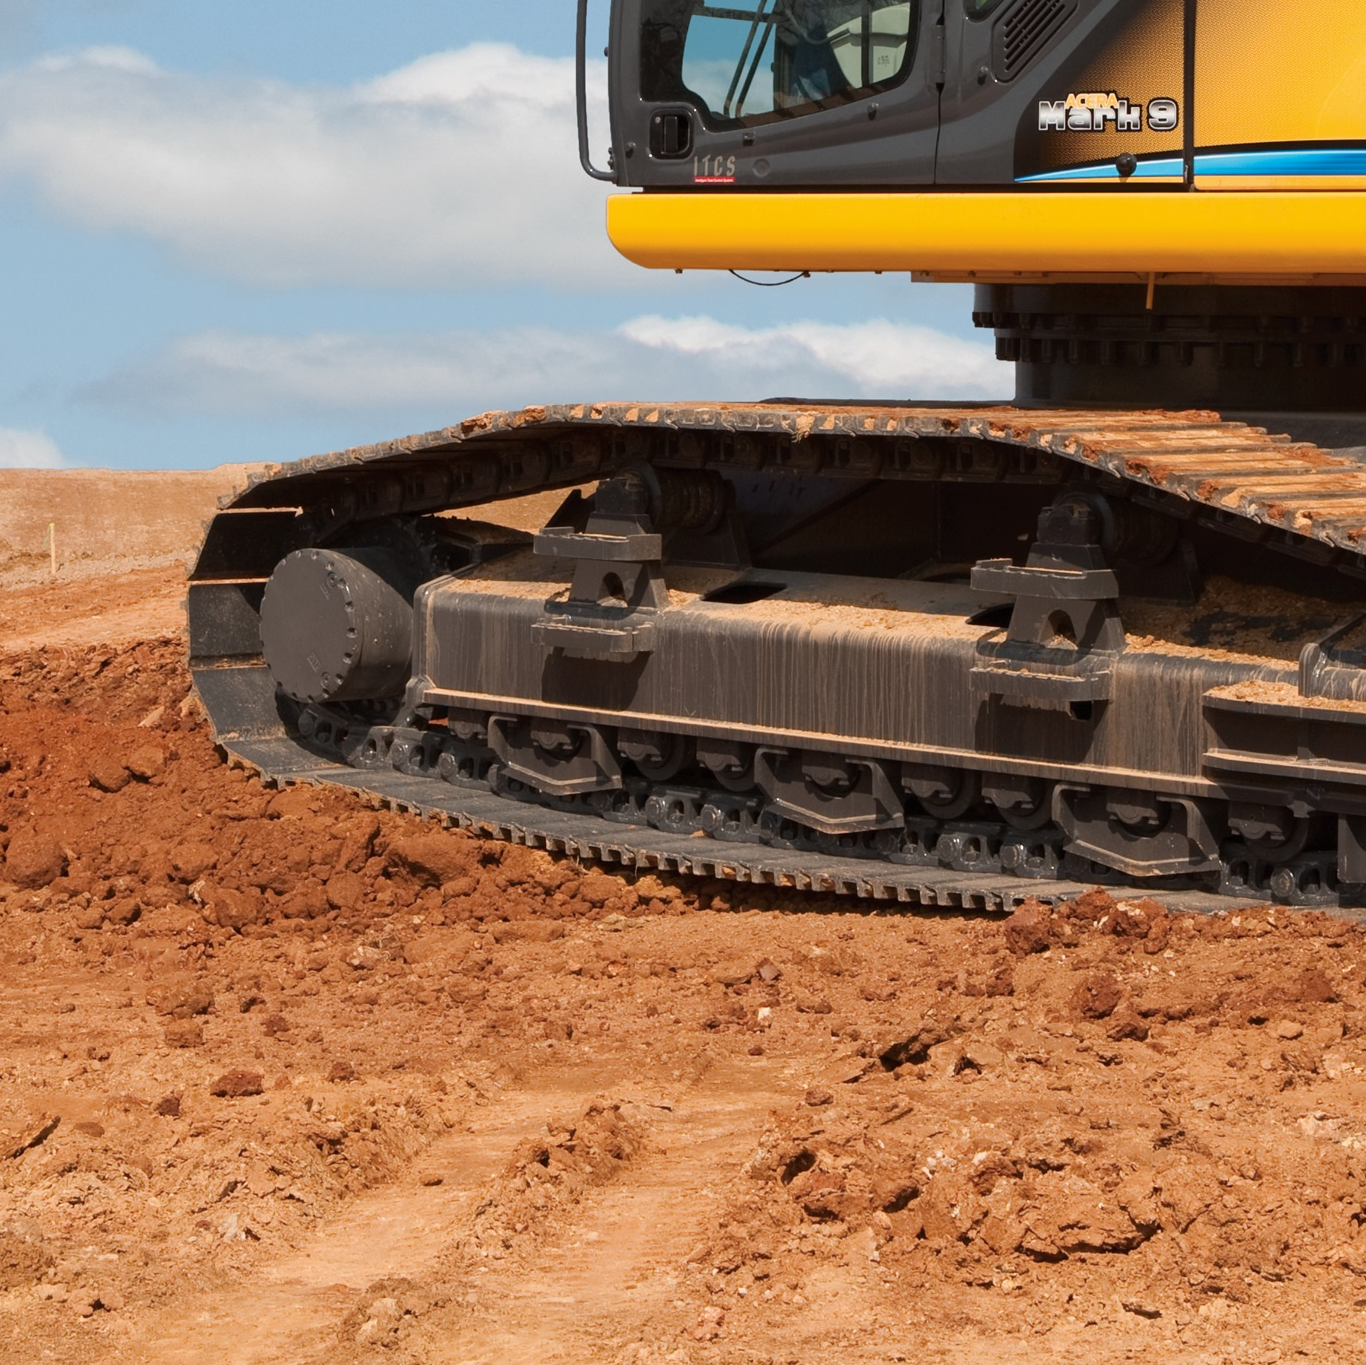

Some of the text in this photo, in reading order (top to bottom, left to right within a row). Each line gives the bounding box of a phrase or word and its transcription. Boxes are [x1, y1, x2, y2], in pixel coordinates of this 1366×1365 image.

[1065, 93, 1119, 109] ACERA
[1038, 99, 1178, 131] Mark 9
[693, 154, 736, 177] ITCS
